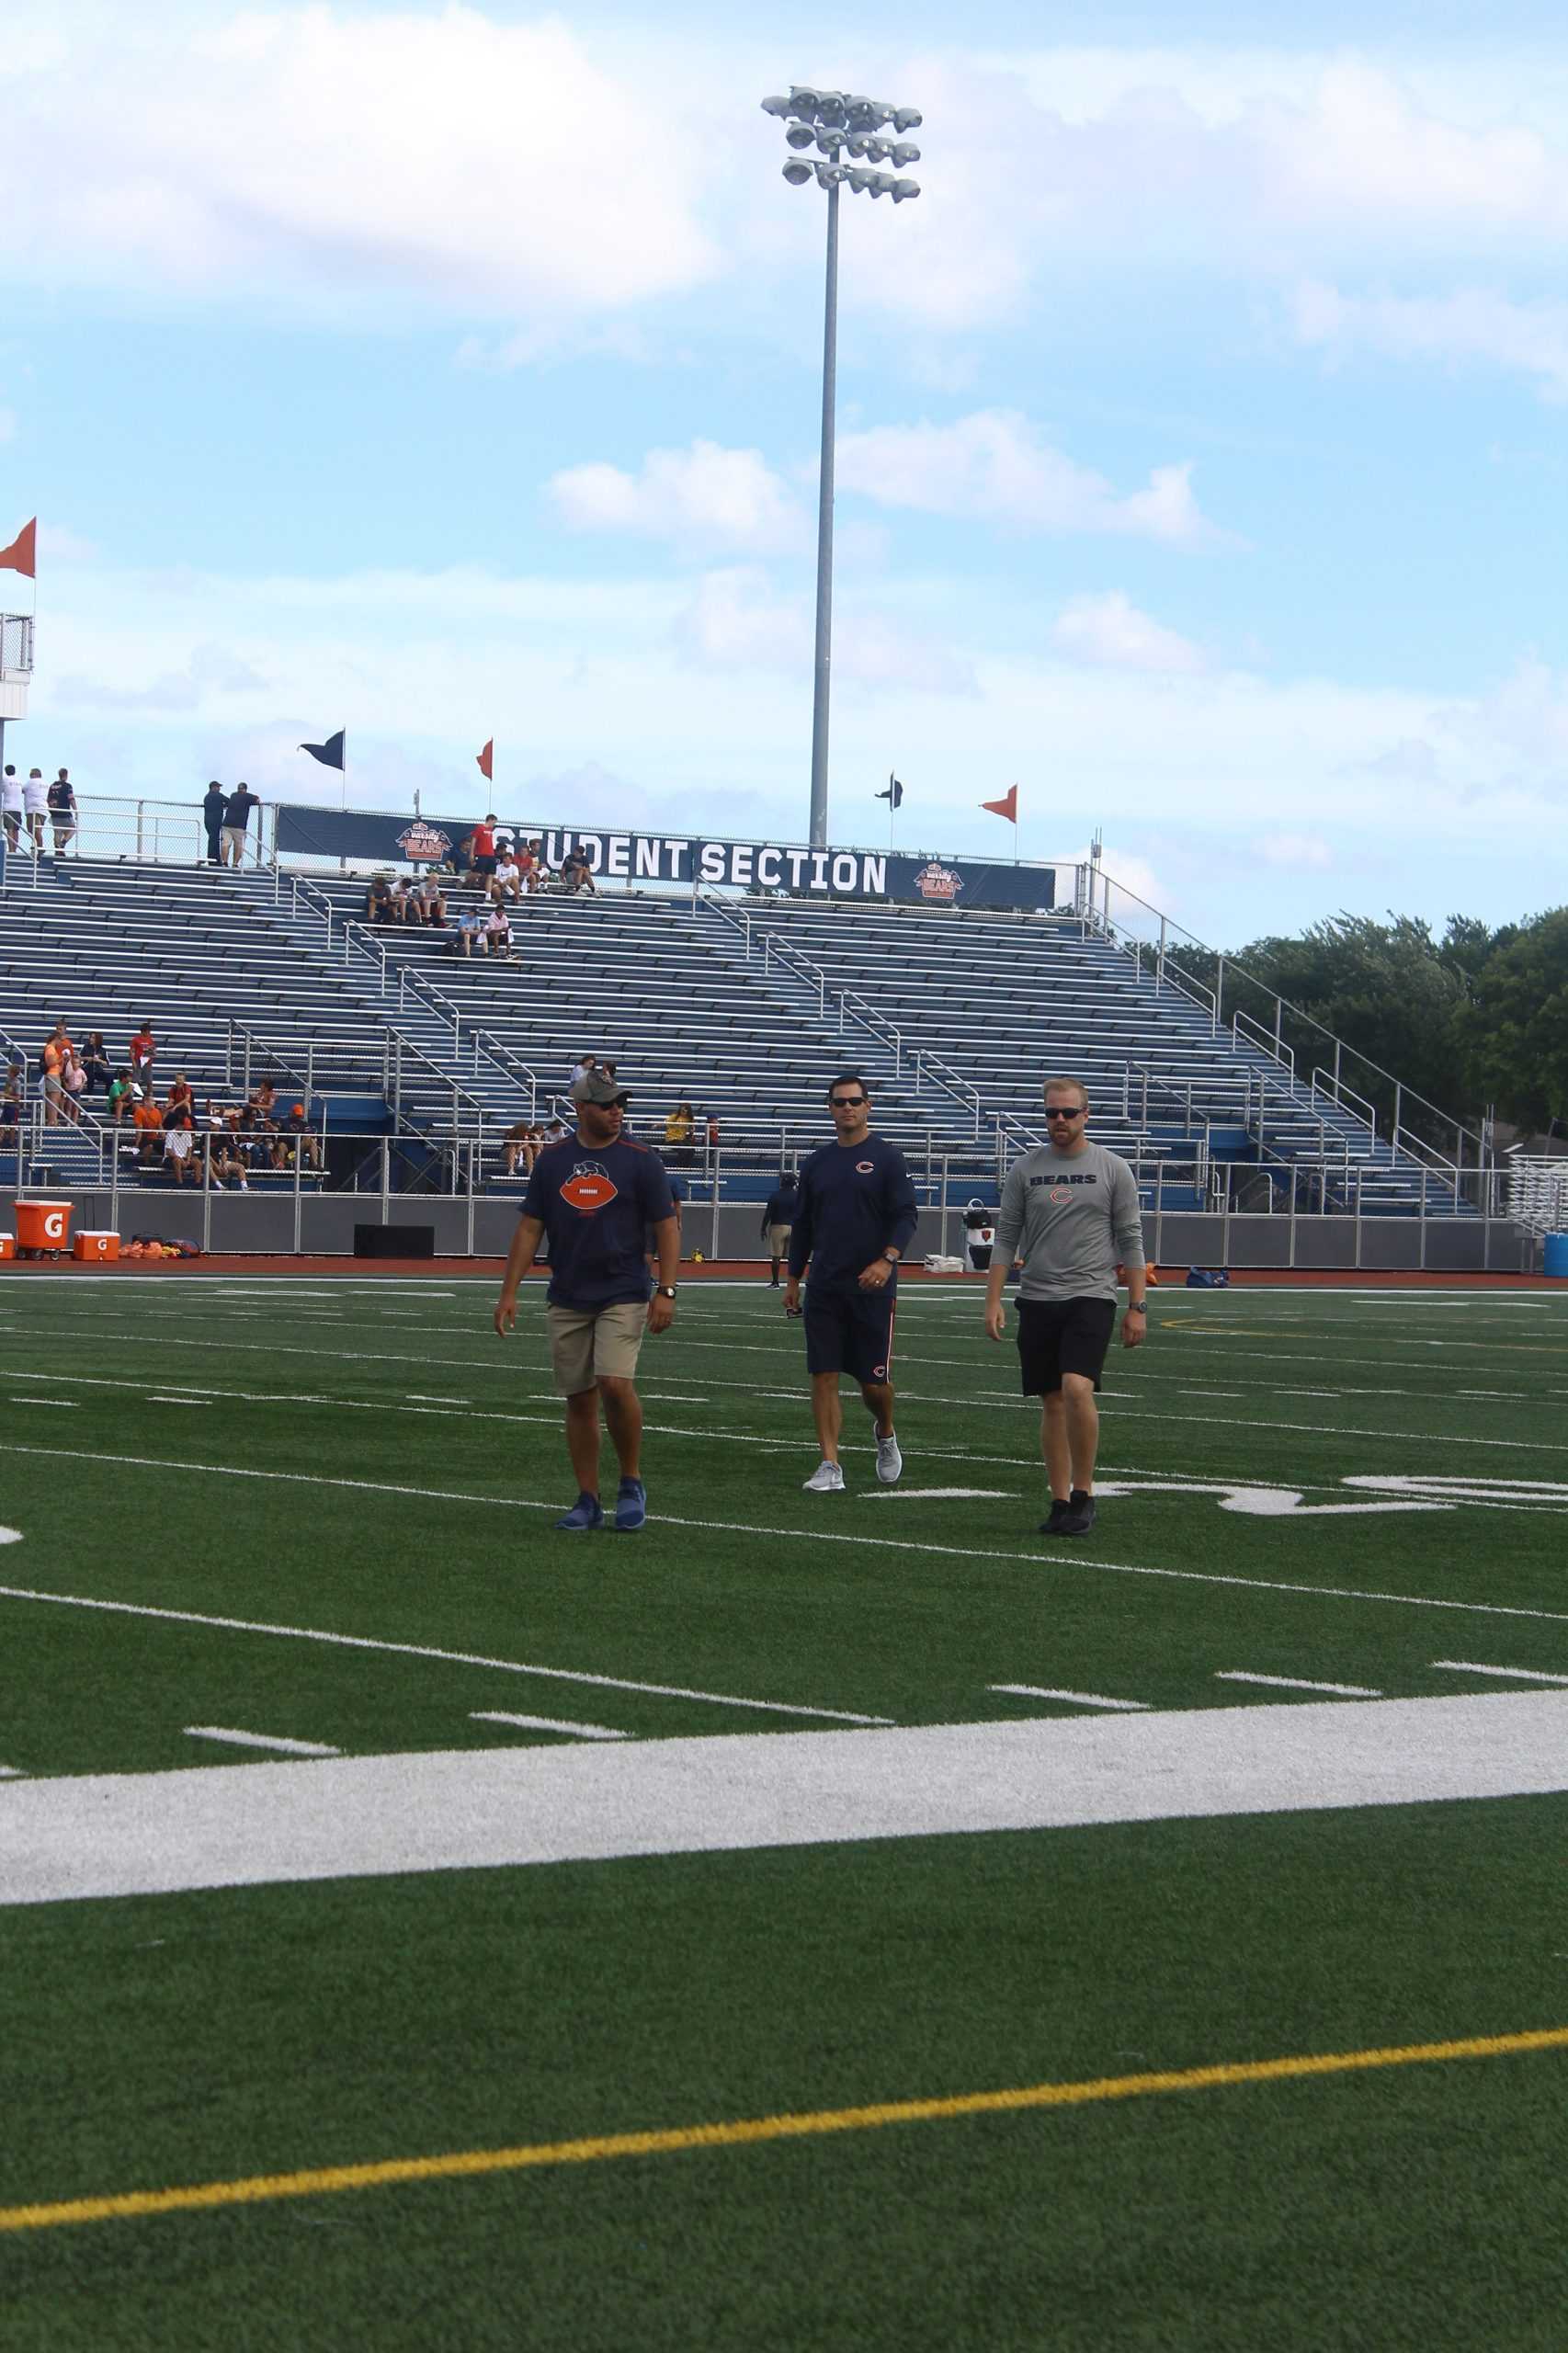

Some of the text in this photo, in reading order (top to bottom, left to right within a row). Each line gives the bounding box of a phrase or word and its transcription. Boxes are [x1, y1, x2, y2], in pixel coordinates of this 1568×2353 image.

[492, 827, 886, 893] STUDENT SECTION
[1029, 1174, 1096, 1186] BEARS
[44, 1212, 63, 1238] G
[97, 1238, 108, 1251] G
